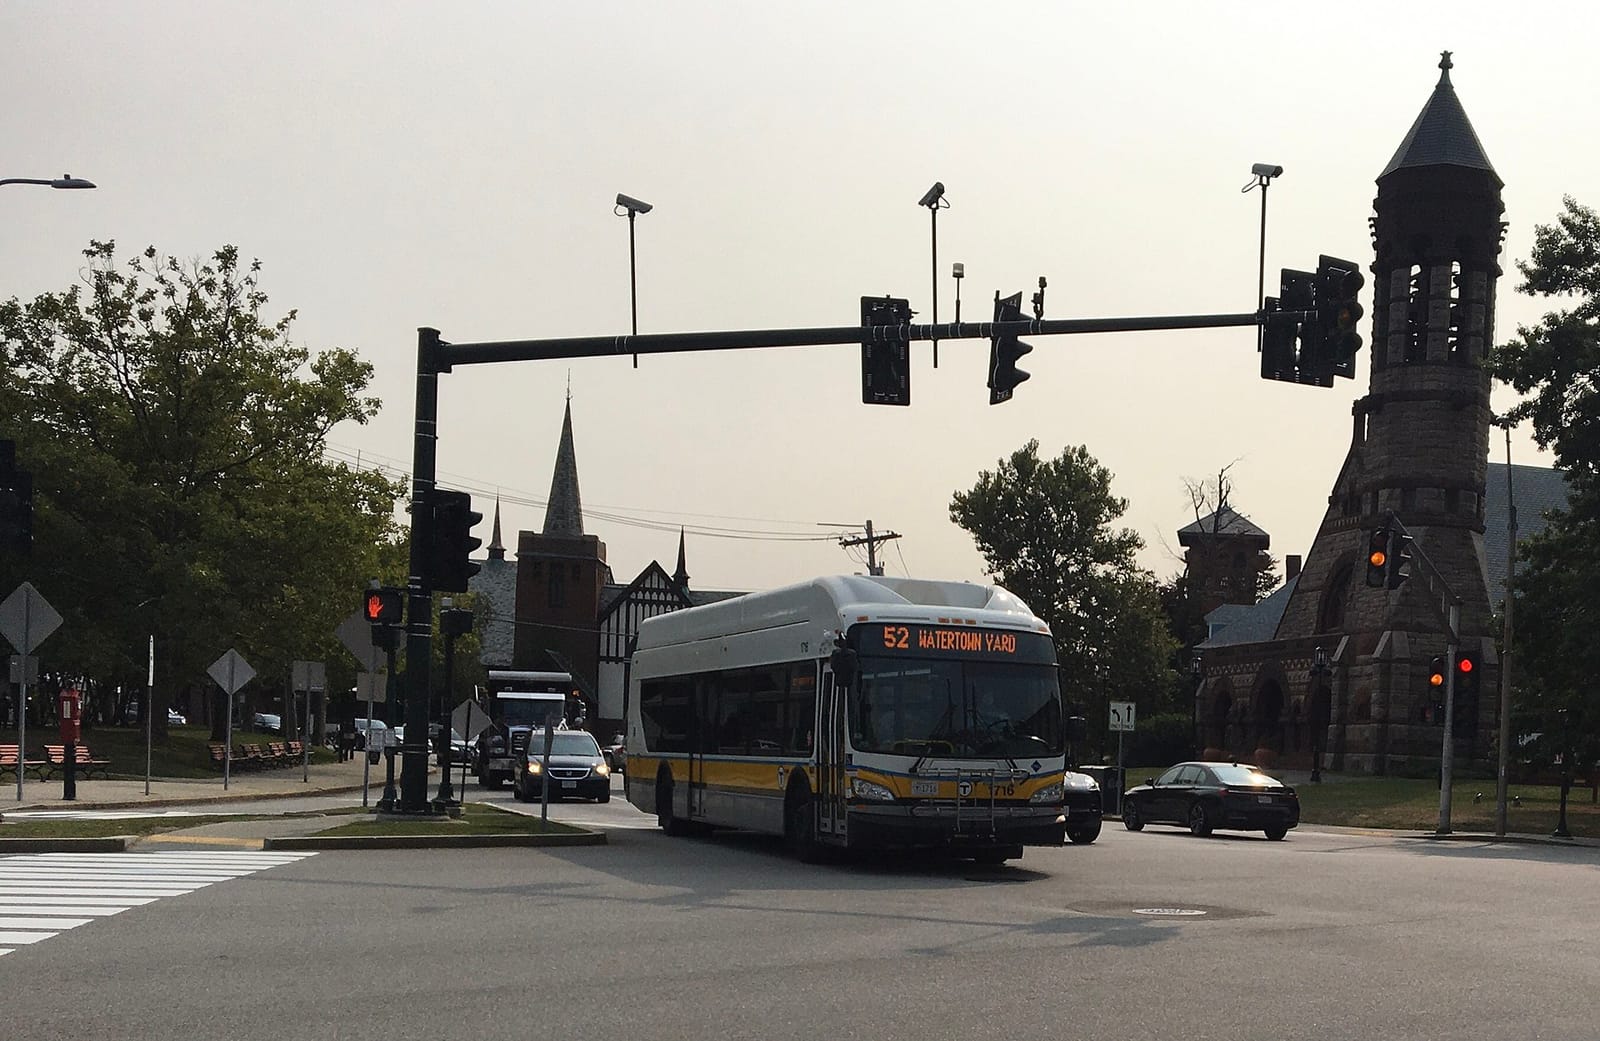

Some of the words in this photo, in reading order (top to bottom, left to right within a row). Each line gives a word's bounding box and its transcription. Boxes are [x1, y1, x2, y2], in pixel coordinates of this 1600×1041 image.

[883, 626, 909, 649] 52
[919, 630, 982, 651] WATERTOWN
[985, 633, 1016, 653] YARD
